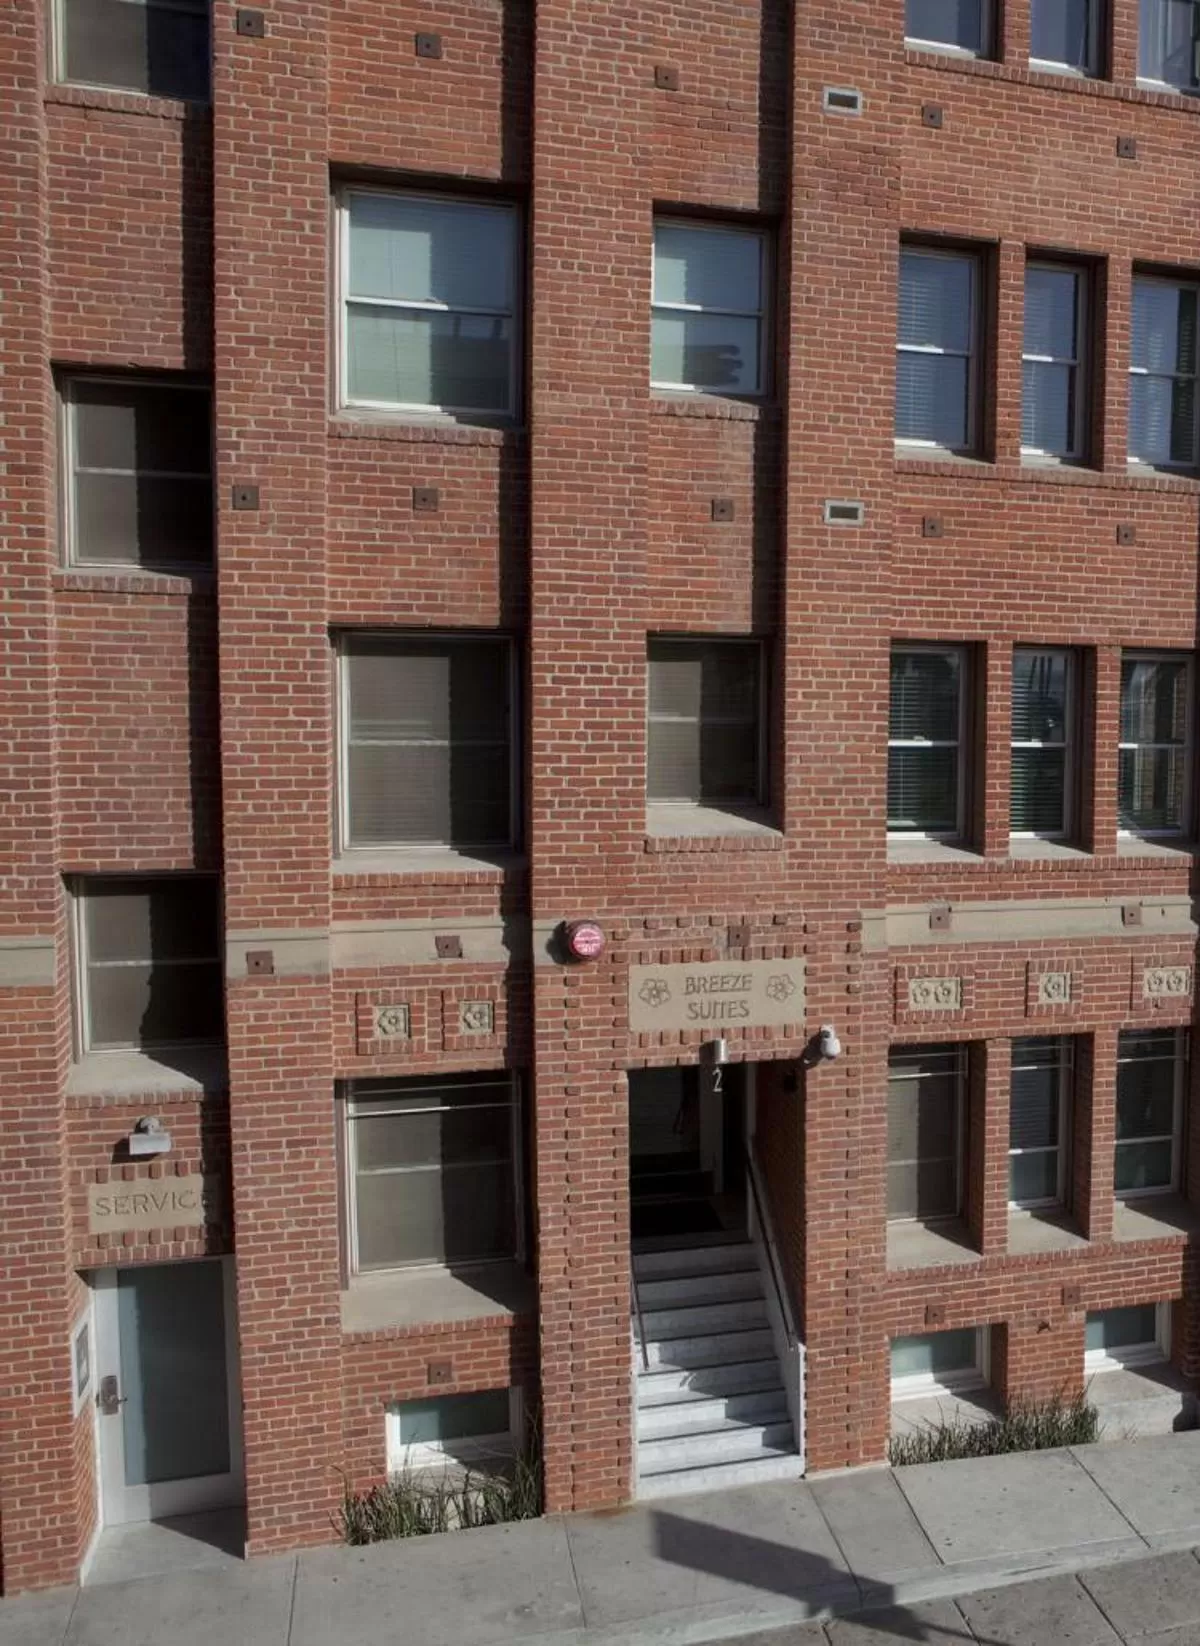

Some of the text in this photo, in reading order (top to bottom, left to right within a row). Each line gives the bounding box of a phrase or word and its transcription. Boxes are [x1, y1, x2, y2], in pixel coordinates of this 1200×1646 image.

[684, 974, 752, 996] BREEZE
[687, 1000, 750, 1020] SUITES
[711, 1067, 723, 1092] 2
